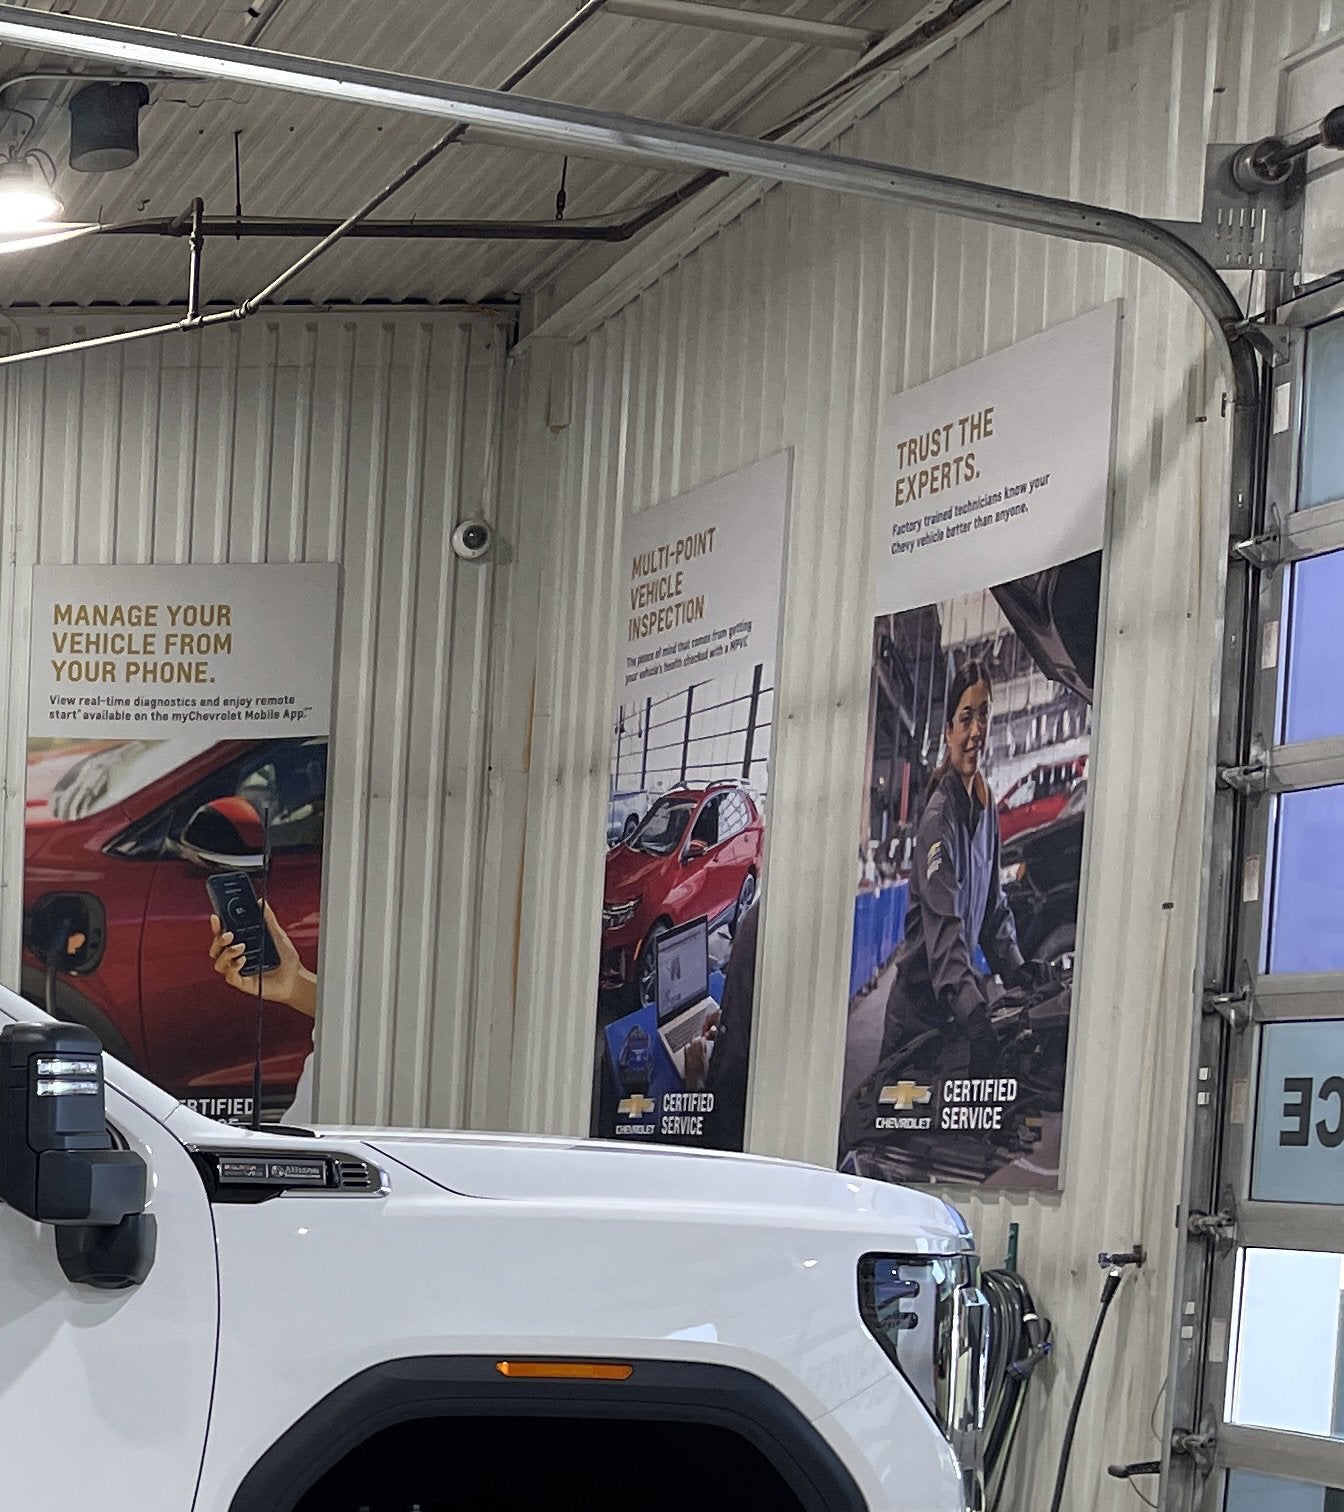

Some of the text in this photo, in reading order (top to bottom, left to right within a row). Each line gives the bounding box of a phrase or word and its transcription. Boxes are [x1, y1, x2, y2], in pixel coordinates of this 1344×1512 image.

[896, 406, 994, 470] TRUST THE
[894, 452, 980, 507] EXPERTS.
[892, 473, 1051, 537] Factory trained technicians know your
[891, 502, 1029, 555] Chevy vehicle better than anyone.
[631, 526, 716, 580] MULTI-POINT
[630, 571, 684, 611] VEHICLE
[53, 603, 232, 627] MANAGE YOUR
[628, 595, 705, 641] INSPECTION
[52, 632, 232, 655] VEHICLE FROM
[50, 659, 216, 684] YOUR PHONE.
[49, 694, 295, 709] View real-time diagnostics and enjoy remote
[83, 709, 131, 721] available
[134, 710, 148, 721] on
[150, 709, 169, 721] the
[171, 709, 242, 723] myChevrolet
[244, 708, 280, 720] Mobile
[943, 1078, 1018, 1102] CERTIFIED
[663, 1093, 715, 1113] CERTIFIED
[615, 1124, 656, 1135] CHEVROLET
[661, 1116, 704, 1136] SERVICE
[875, 1117, 931, 1129] CHEVROLET
[941, 1106, 1003, 1130] SERVICE
